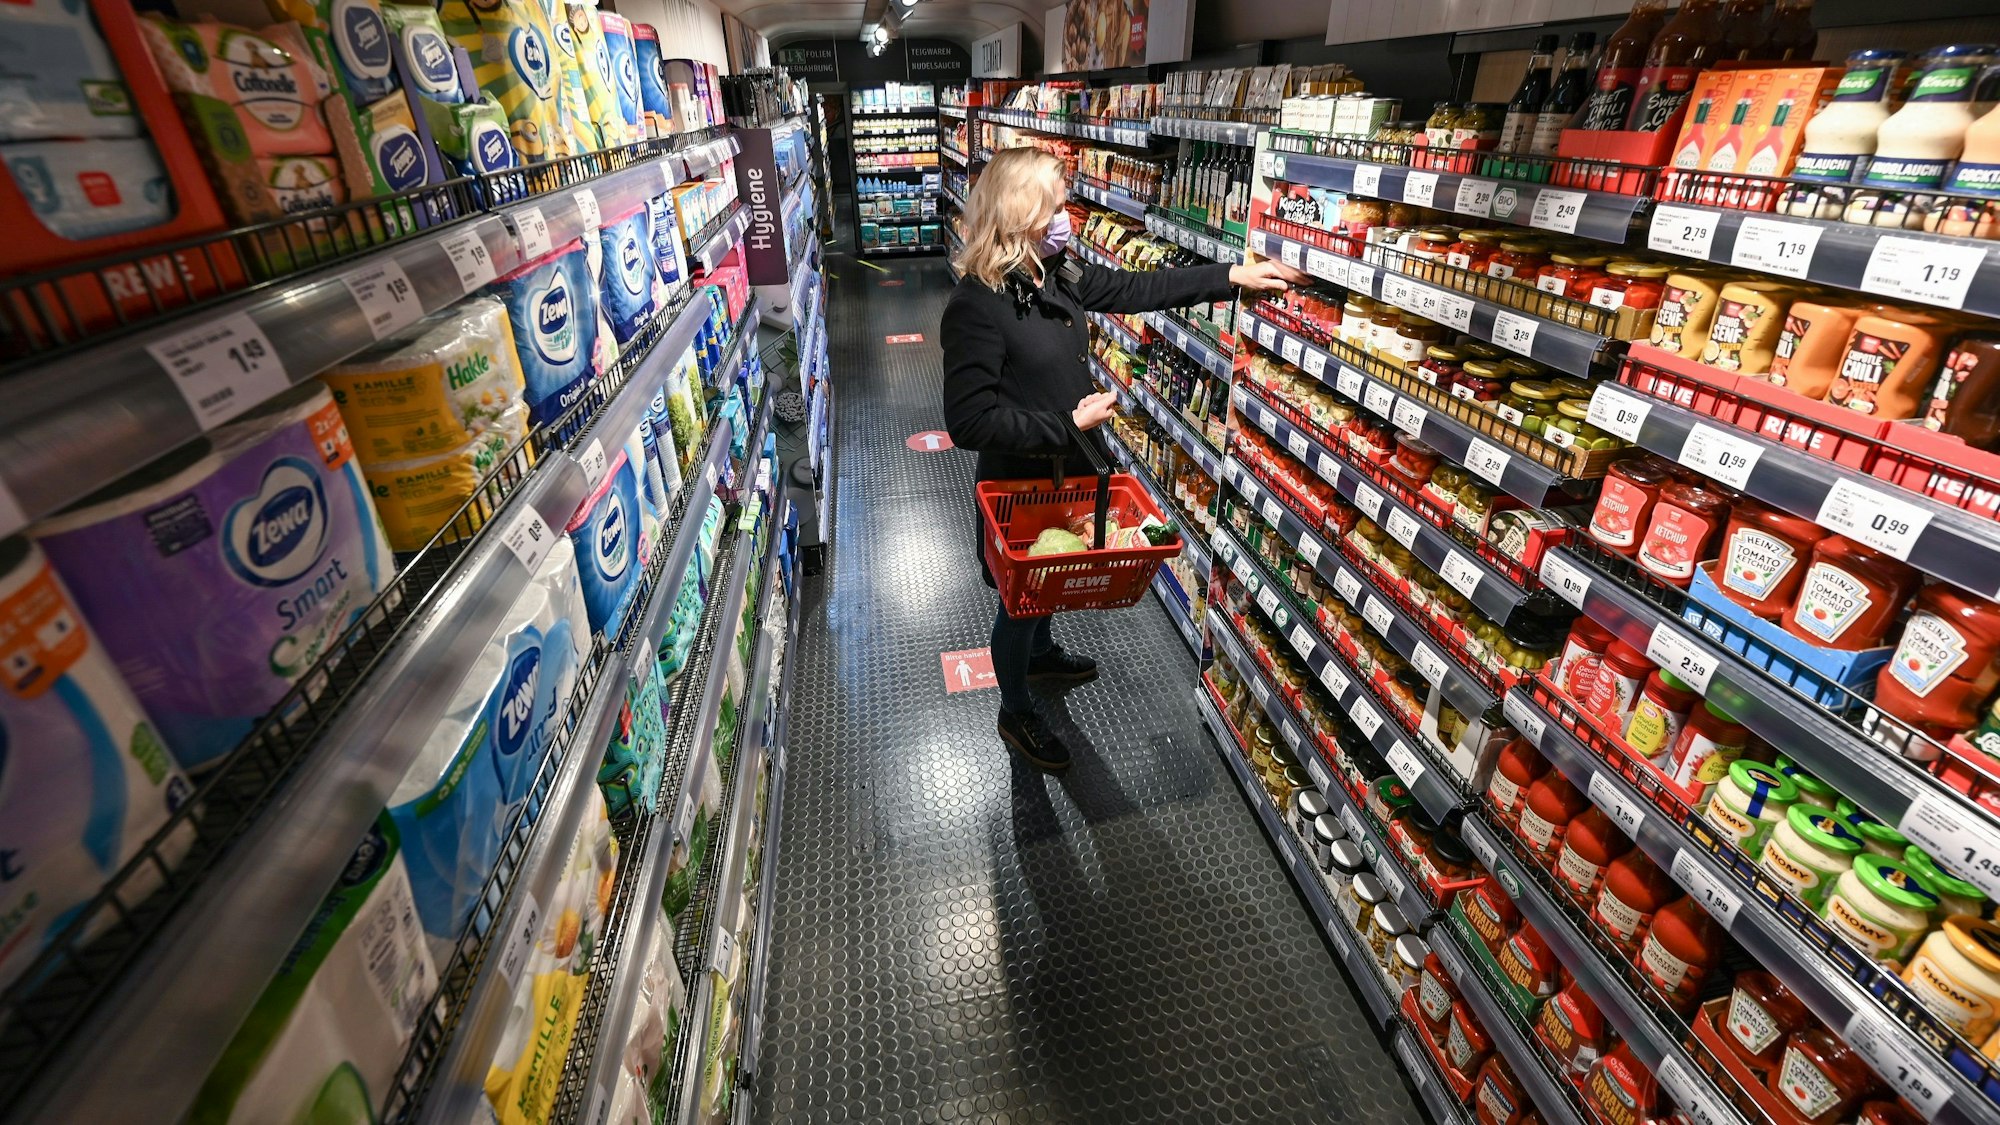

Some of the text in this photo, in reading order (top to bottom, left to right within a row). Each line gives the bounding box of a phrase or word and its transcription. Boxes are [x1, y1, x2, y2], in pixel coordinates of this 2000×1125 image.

[911, 48, 951, 56] TEIGWAREN
[912, 61, 961, 70] NUDELSAUCEN
[233, 71, 297, 96] Cottonelle
[1647, 90, 1687, 110] SWEE
[1708, 73, 1732, 127] CLASSIC
[1743, 72, 1773, 129] CLASSIC
[1589, 101, 1627, 123] CHILI
[972, 118, 981, 164] Teigwaren
[751, 168, 775, 250] Hygiene
[1475, 192, 1490, 206] 2.99
[1556, 204, 1576, 219] 2.49
[1682, 225, 1707, 242] 2.79
[1777, 241, 1806, 259] 1.19
[1923, 264, 1961, 284] 1.19
[1454, 308, 1468, 320] 3.29
[1657, 308, 1684, 327] SENF
[1513, 328, 1530, 342] 3.29
[1712, 323, 1743, 344] SENF
[446, 351, 489, 391] Hakle
[1841, 358, 1883, 384] CHILI
[354, 375, 415, 391] KAMILLE
[1616, 409, 1639, 425] 0.99
[1484, 457, 1502, 472] 2.29
[1718, 451, 1747, 469] 0.99
[395, 465, 451, 485] KAMILLE
[1601, 496, 1630, 515] KETCHUP
[252, 502, 312, 556] Zewa
[1654, 525, 1688, 546] KETCHUP
[1870, 513, 1910, 537] 0.99
[1736, 535, 1781, 575] HEINZ TOMATO KETCHUP
[1063, 575, 1112, 589] REWE
[1460, 570, 1475, 585] 1.49
[1563, 577, 1582, 594] 0.99
[276, 558, 348, 631] Smart
[1061, 586, 1108, 597] www.rewe.de
[1809, 571, 1855, 615] HEINZ TOMATO KETCHUP
[1906, 618, 1951, 665] HEINZ TOMATO KETCHUP
[944, 653, 963, 662] Bitte
[963, 651, 985, 659] haltet
[1680, 656, 1706, 677] 2.59
[1523, 718, 1538, 736] 1.59
[1634, 717, 1658, 736] Ketchup
[1637, 710, 1659, 730] Gewürz
[1614, 803, 1634, 825] 1.59
[1711, 798, 1747, 830] THOMY
[1767, 843, 1810, 882] THOMY
[1963, 846, 2000, 878] 1.49
[1705, 888, 1729, 913] 1.99
[1467, 906, 1498, 942] KETCHUP
[1469, 899, 1500, 937] TOMATEN
[1834, 901, 1886, 943] THOMY
[1500, 943, 1532, 980] TOMATEN
[1919, 965, 1982, 1010] THOMY
[1735, 996, 1770, 1038] HEINZ TOMATO KETCHUP
[517, 994, 563, 1111] KAMILLE
[1604, 1069, 1635, 1105] Develey
[1788, 1058, 1828, 1103] HEINZ TOMATO KETCHUP
[1896, 1064, 1933, 1100] 1.69
[1593, 1071, 1635, 1125] TOMATEN
